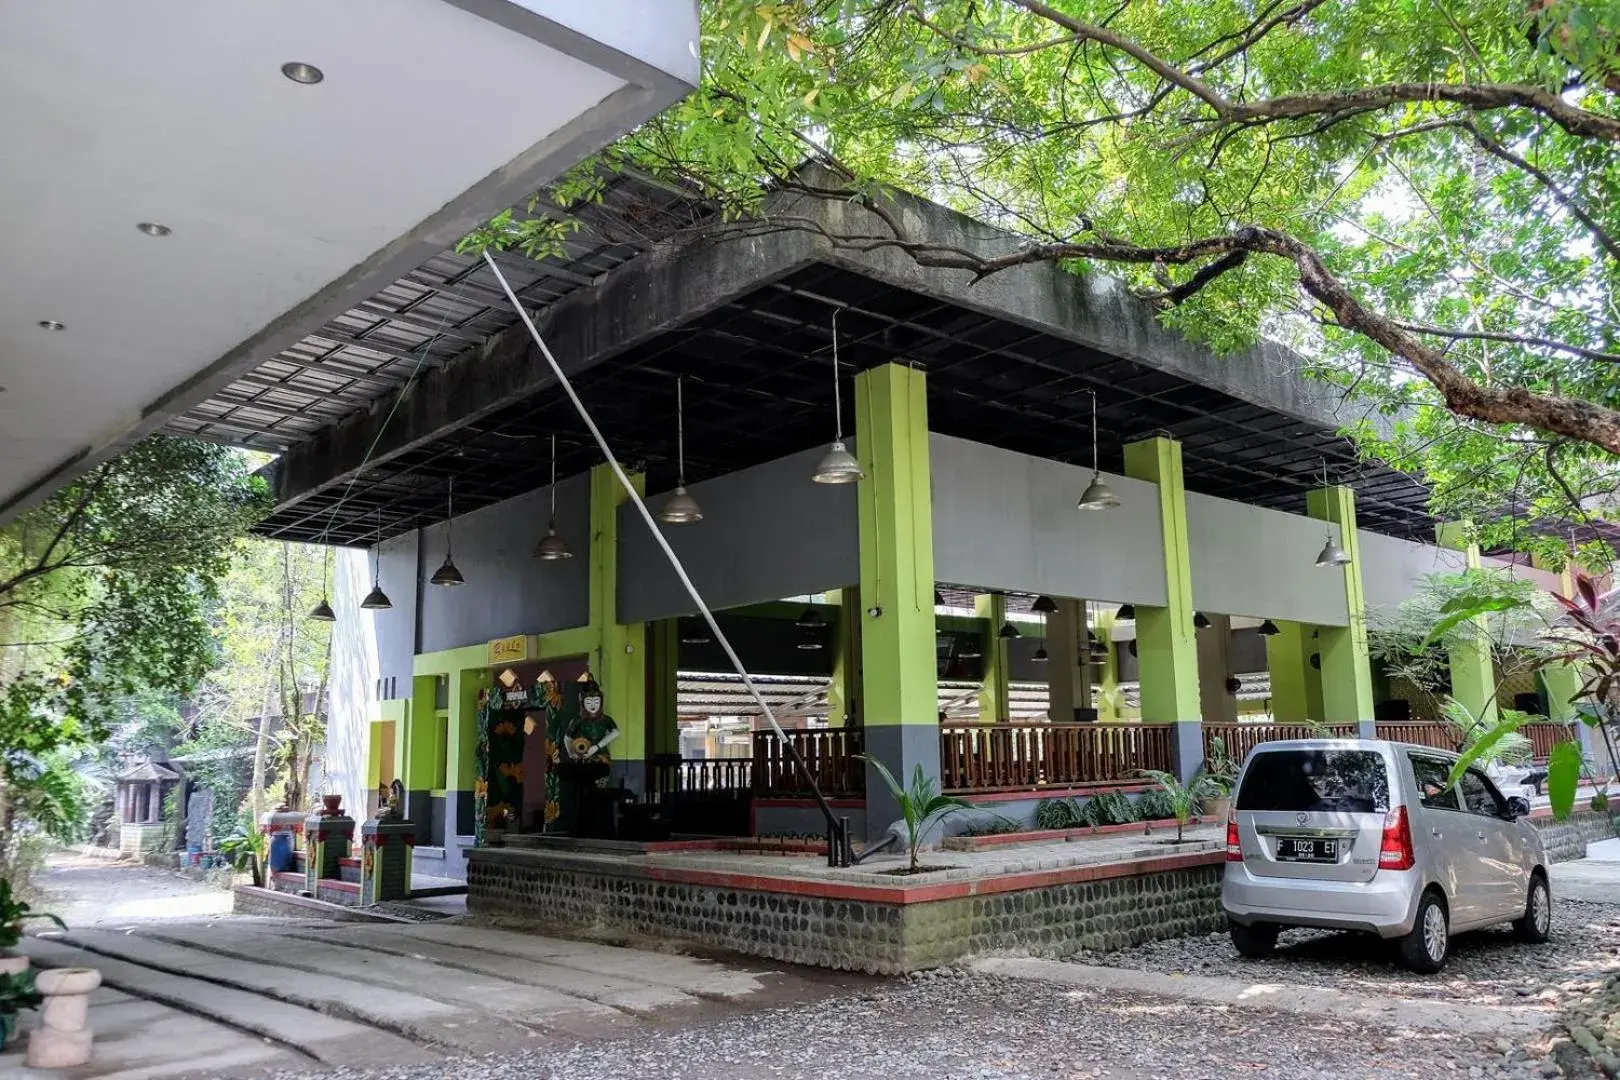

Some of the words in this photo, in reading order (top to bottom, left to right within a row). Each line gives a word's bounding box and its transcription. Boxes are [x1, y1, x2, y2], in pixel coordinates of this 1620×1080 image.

[1277, 839, 1283, 851] F
[1293, 840, 1314, 852] 1023
[1324, 841, 1336, 853] ET
